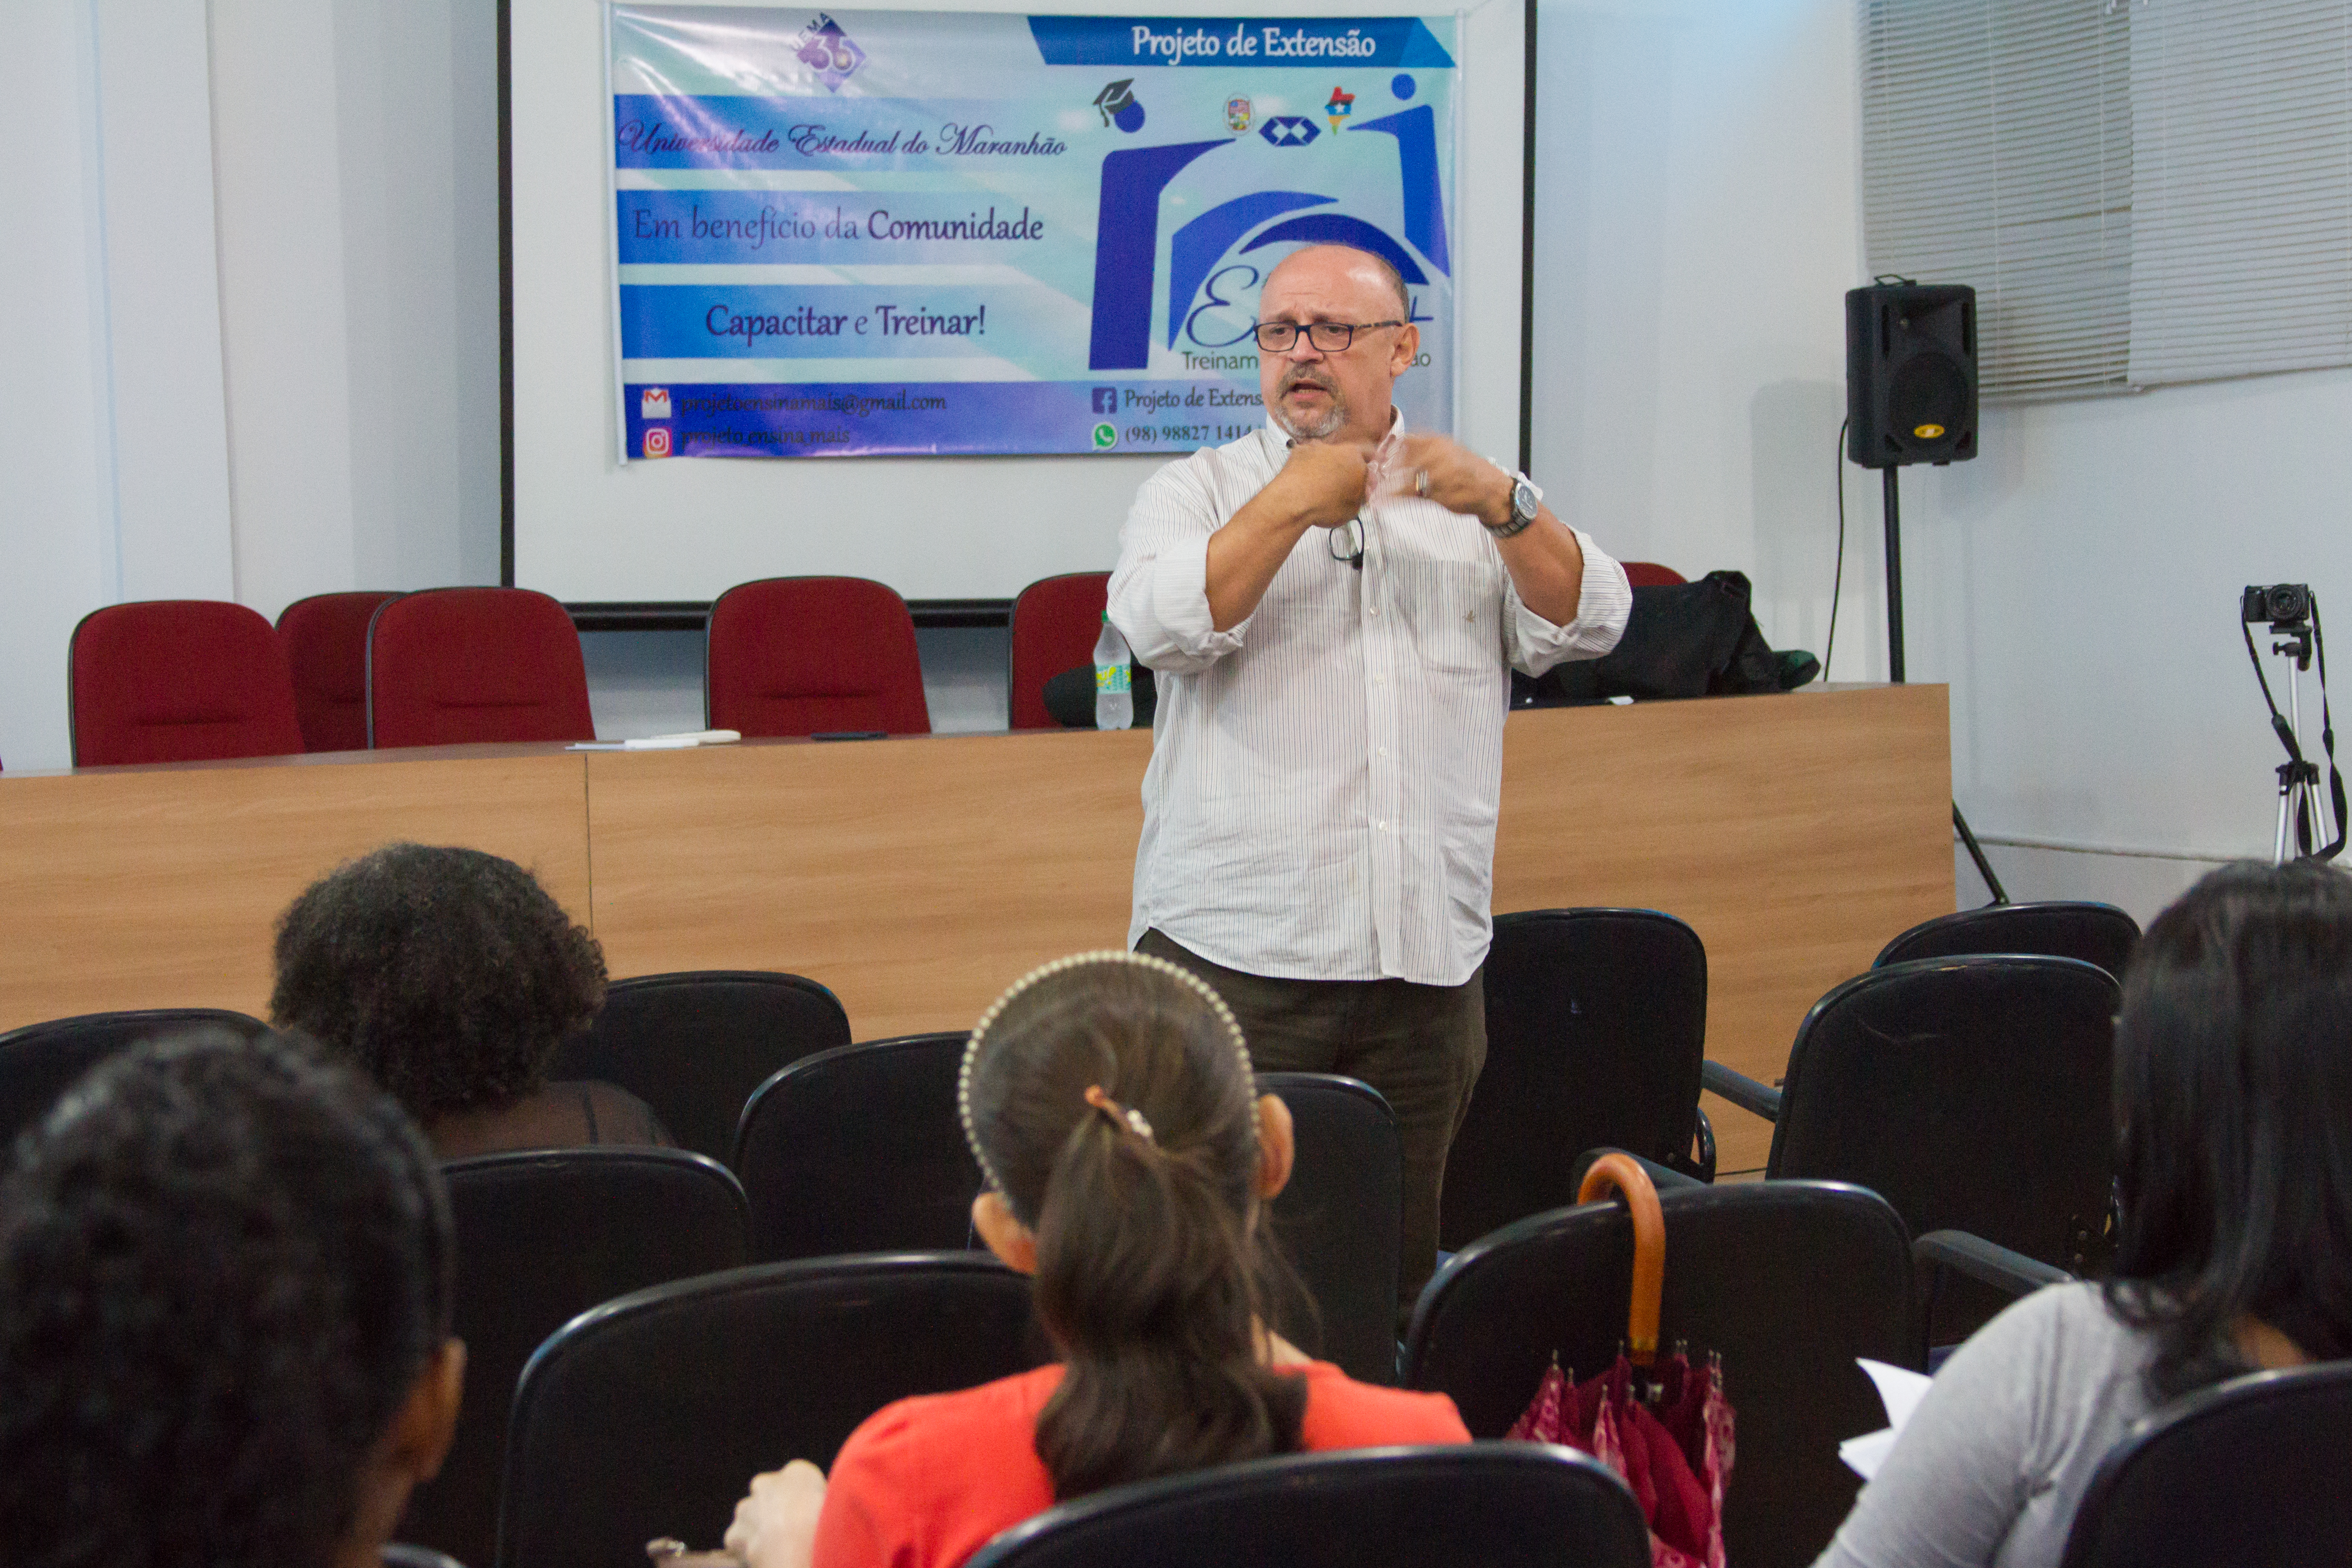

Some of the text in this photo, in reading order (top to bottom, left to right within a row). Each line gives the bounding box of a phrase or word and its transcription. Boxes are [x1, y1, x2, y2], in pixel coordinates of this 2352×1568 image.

[1132, 22, 1376, 65] Projeto de Extensão
[618, 120, 1067, 157] Universidade Estadual do Maranhão
[633, 208, 681, 240] Em
[825, 206, 860, 239] da
[868, 207, 1044, 240] Comunidade
[706, 305, 986, 348] Capacitar e Treinar!
[1181, 351, 1259, 370] Treinam
[681, 389, 947, 418] projetoensinamais@gmail.com
[1124, 386, 1264, 414] Projeto de Extens
[1125, 425, 1157, 444] (98)
[1162, 425, 1209, 441] 98827
